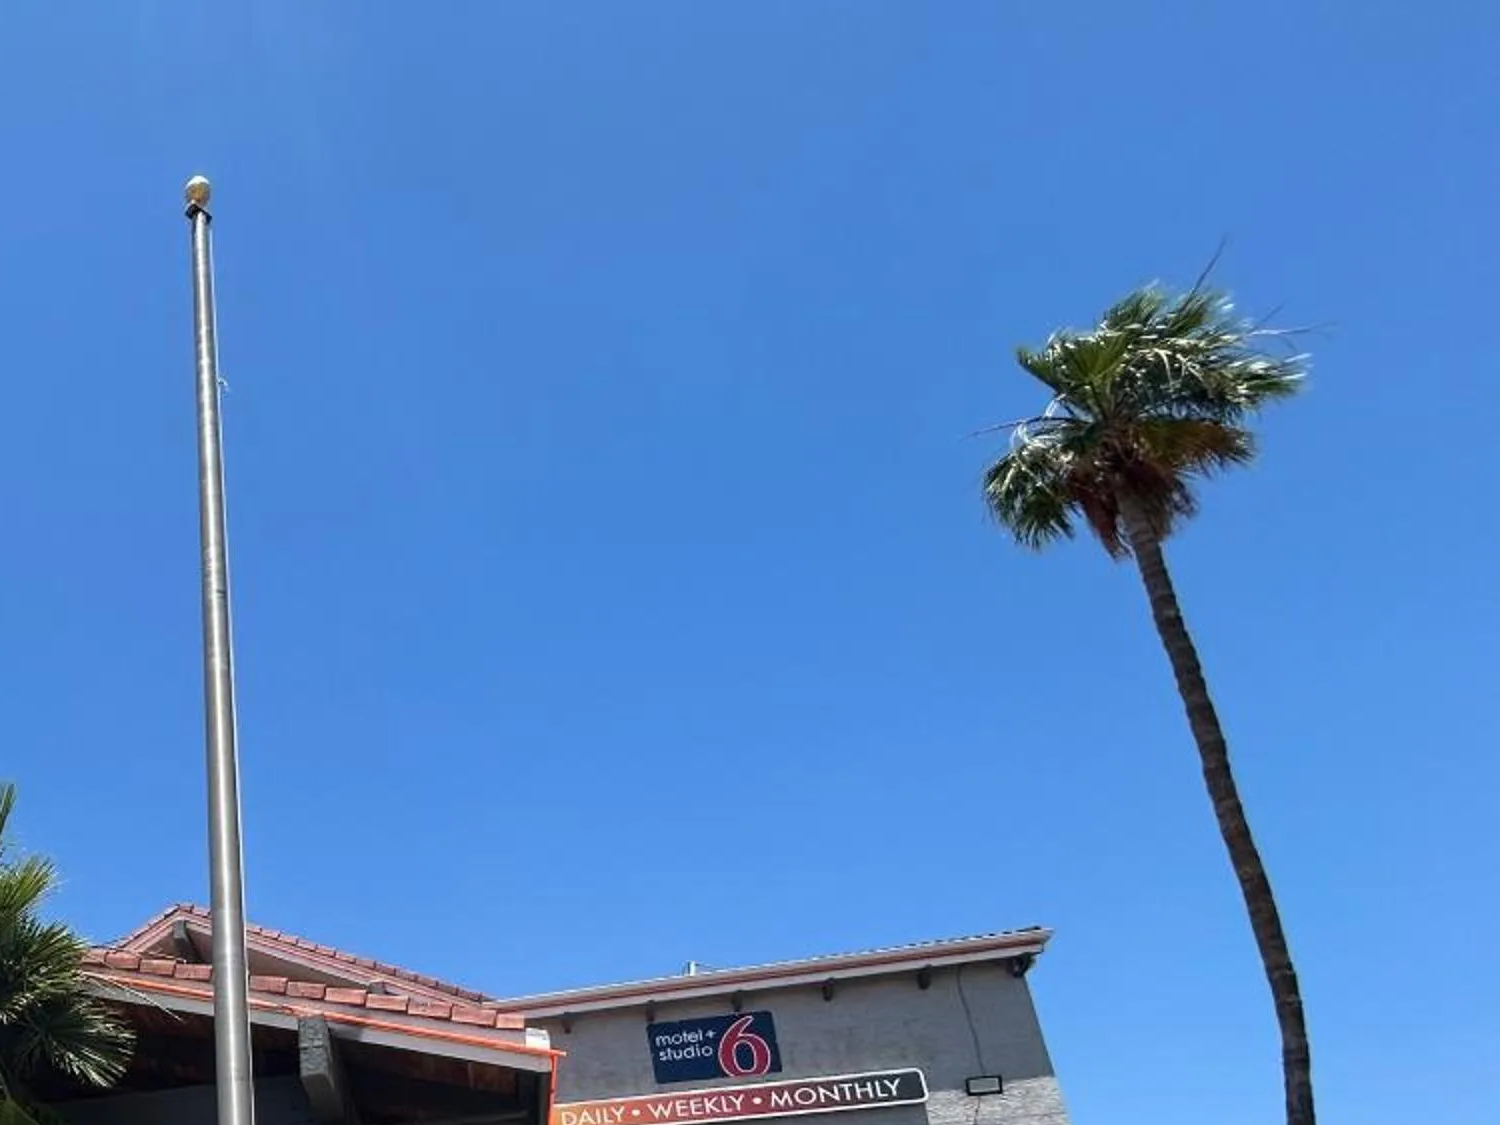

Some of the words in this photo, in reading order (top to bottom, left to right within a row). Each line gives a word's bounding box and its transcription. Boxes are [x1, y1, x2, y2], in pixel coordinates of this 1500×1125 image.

[659, 1044, 713, 1061] studio
[718, 1015, 771, 1077] 6
[647, 1094, 745, 1119] WEEKLY
[771, 1078, 901, 1108] MONTHLY
